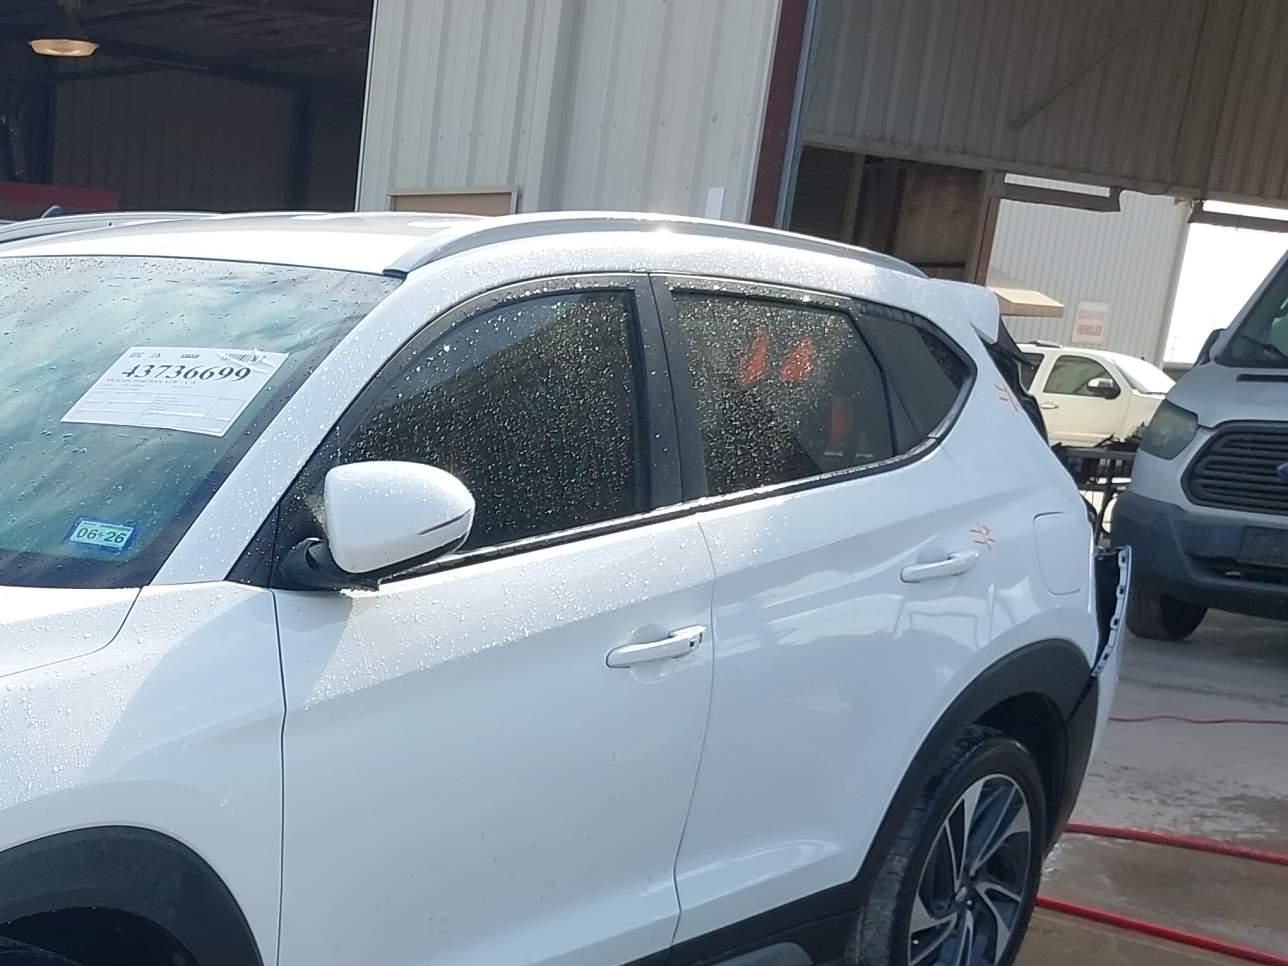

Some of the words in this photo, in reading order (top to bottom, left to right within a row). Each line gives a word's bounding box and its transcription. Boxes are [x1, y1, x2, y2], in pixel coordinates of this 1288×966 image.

[121, 364, 252, 382] 43736699
[76, 527, 98, 539] 06
[103, 531, 127, 543] 26
